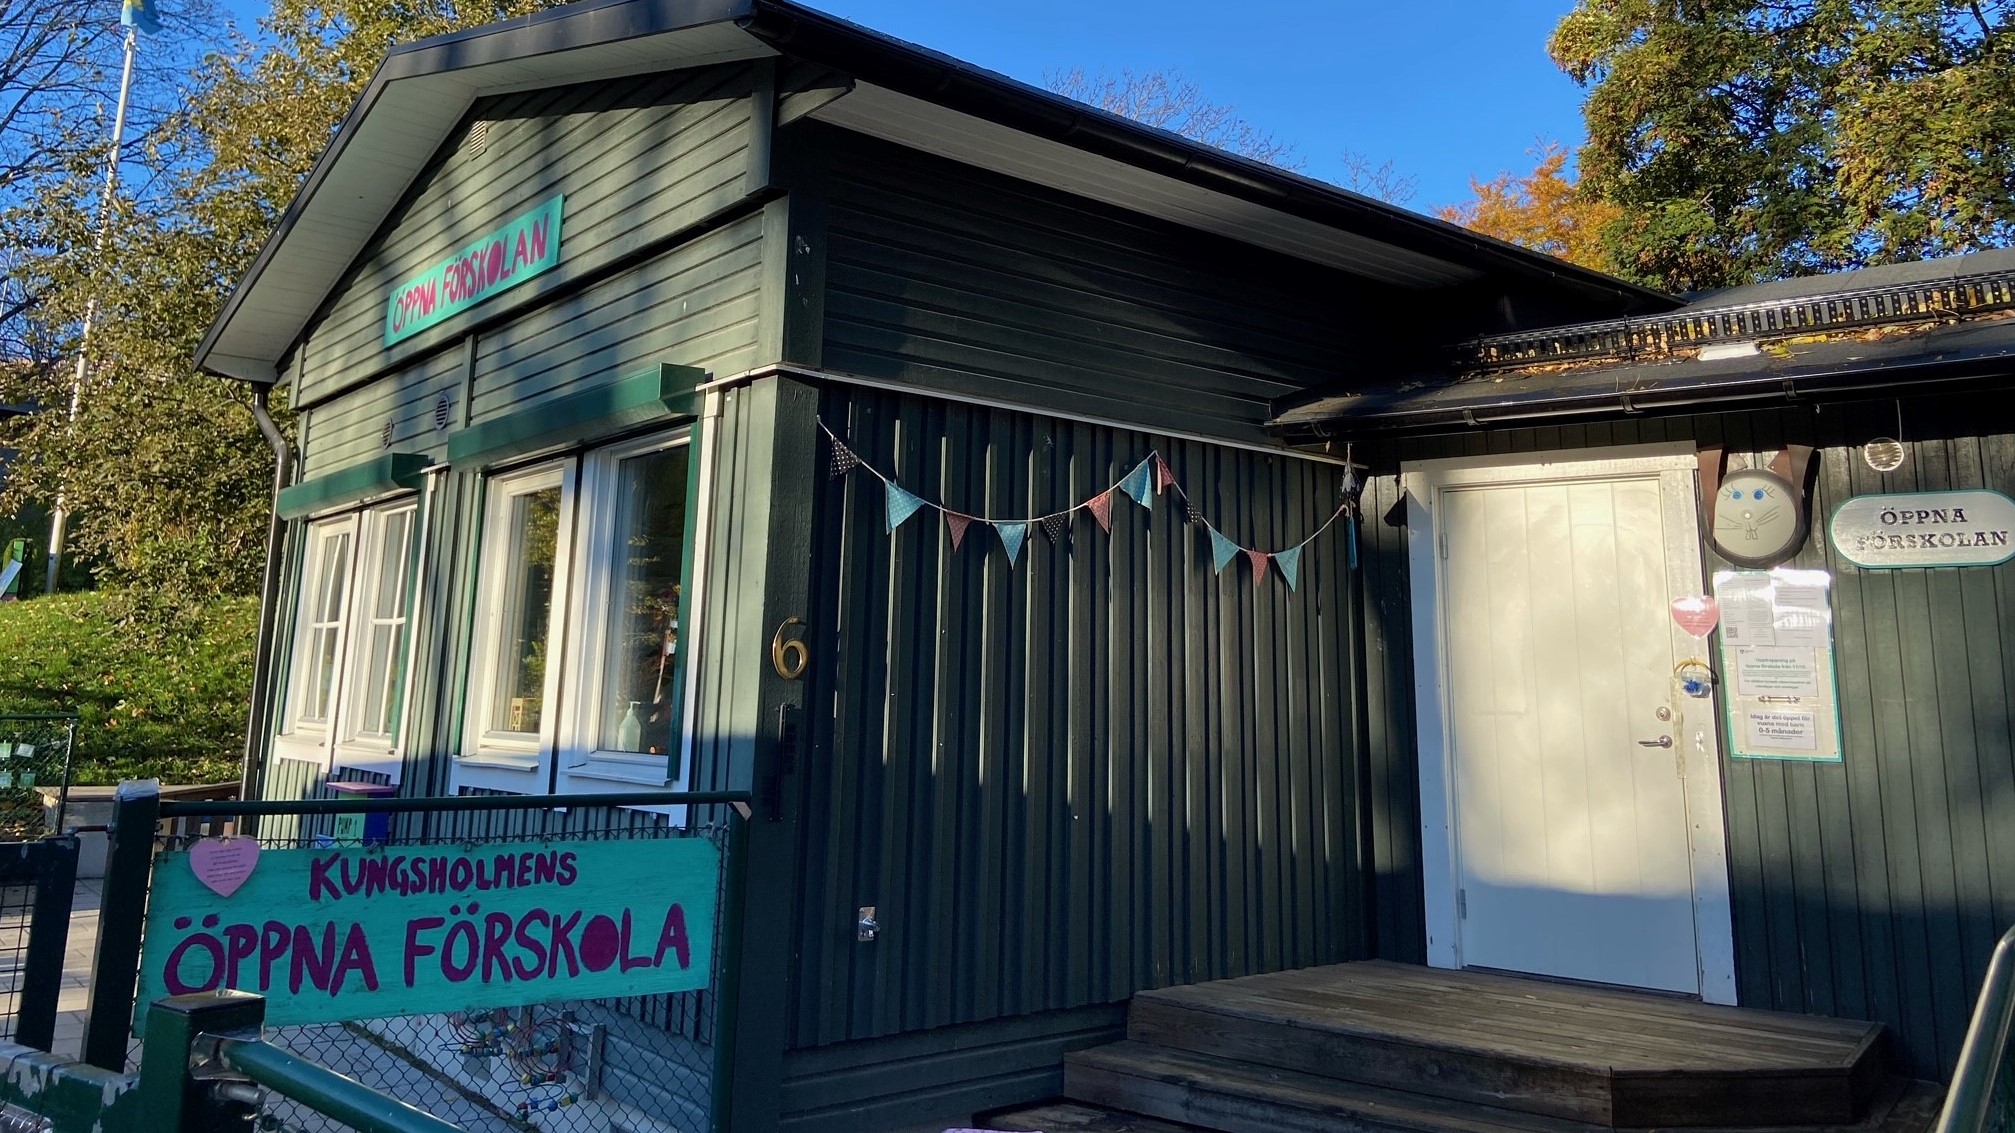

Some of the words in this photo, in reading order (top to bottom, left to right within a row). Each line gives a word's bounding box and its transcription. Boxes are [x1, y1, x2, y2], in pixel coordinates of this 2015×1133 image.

[392, 276, 437, 333] ÖPPNA
[440, 212, 549, 309] FÖRSKOLAN
[1856, 531, 2008, 550] FÖRSKOLAN
[1880, 506, 1968, 526] ÖPPNA
[772, 615, 809, 680] 6
[308, 850, 578, 901] KUNGSHOLMENS
[163, 914, 379, 996] ÖPPNA
[403, 901, 690, 988] FÖRSKOLA
